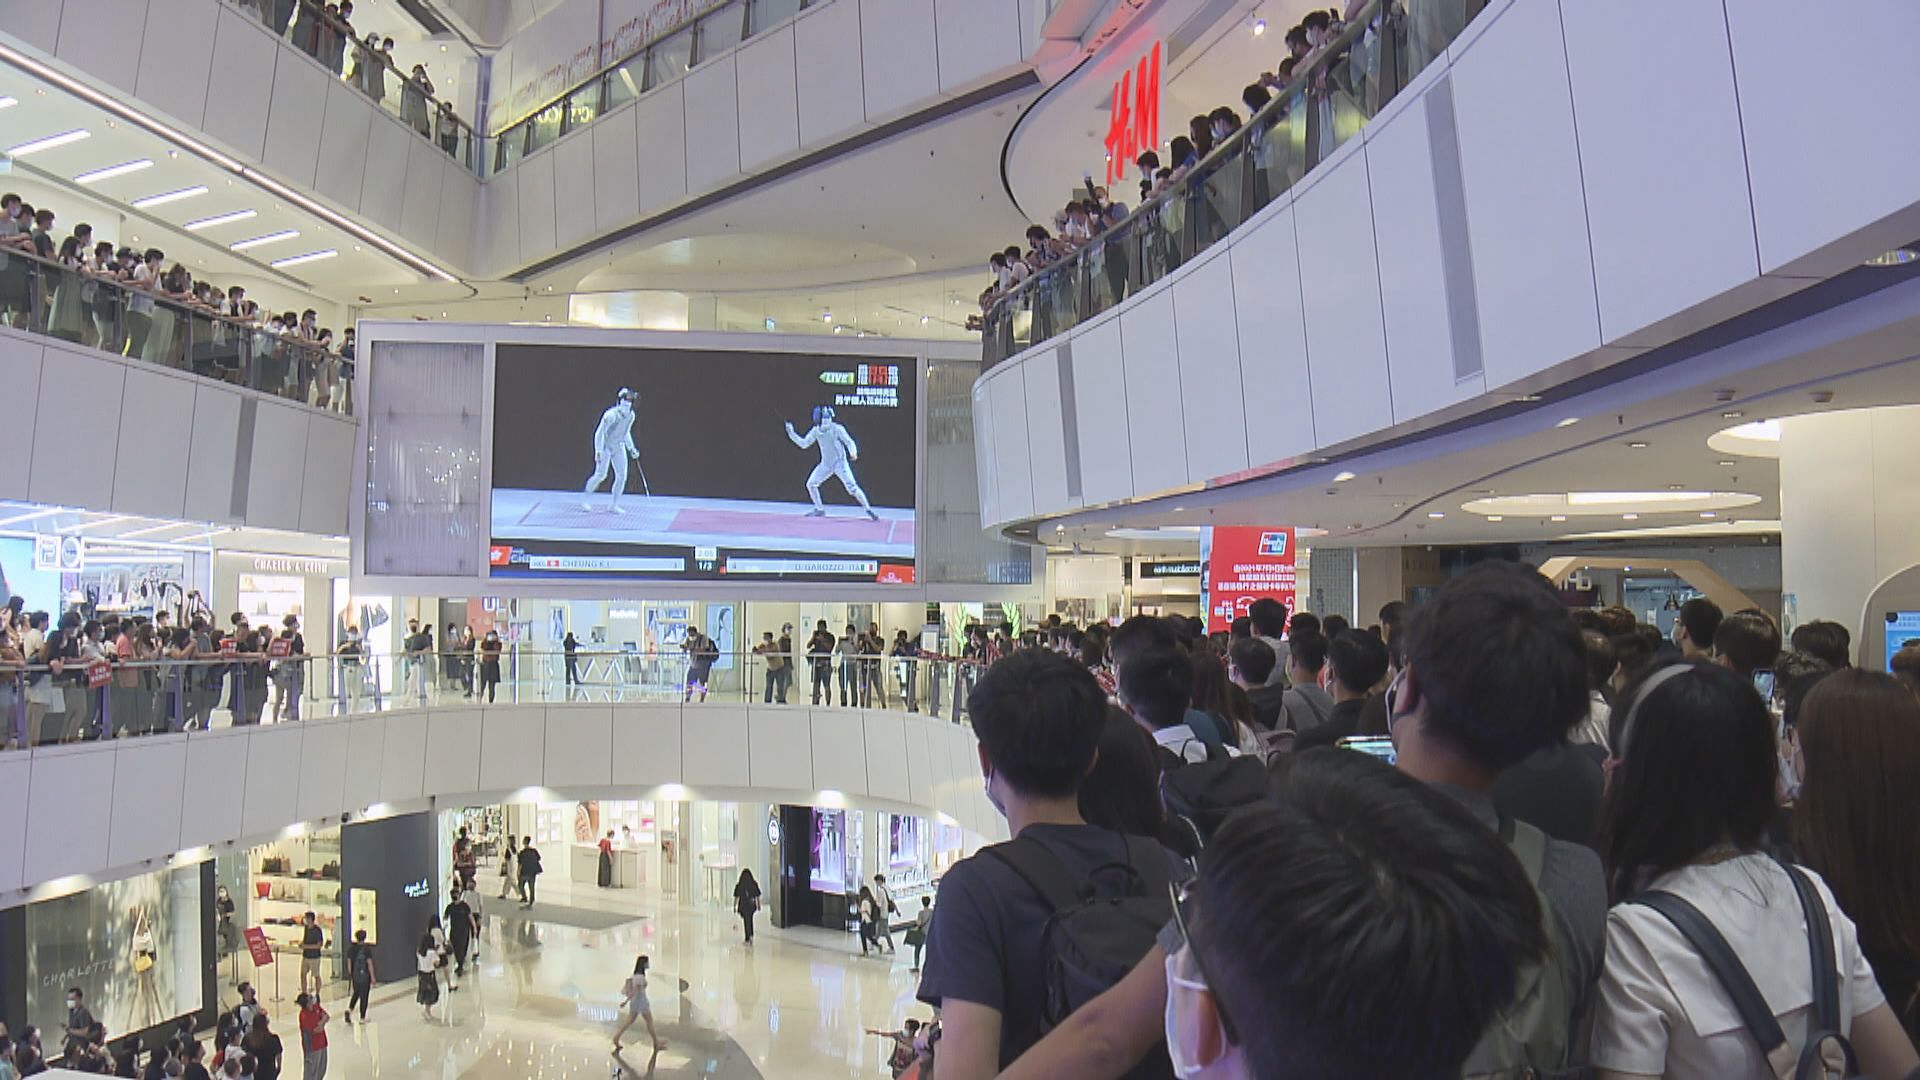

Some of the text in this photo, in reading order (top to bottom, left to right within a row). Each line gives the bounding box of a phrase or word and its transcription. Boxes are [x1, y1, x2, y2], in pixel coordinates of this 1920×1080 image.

[1104, 39, 1161, 186] H&M
[826, 372, 849, 383] LIVE
[698, 561, 713, 571] 1/3
[43, 959, 115, 987] CHARLOTTE
